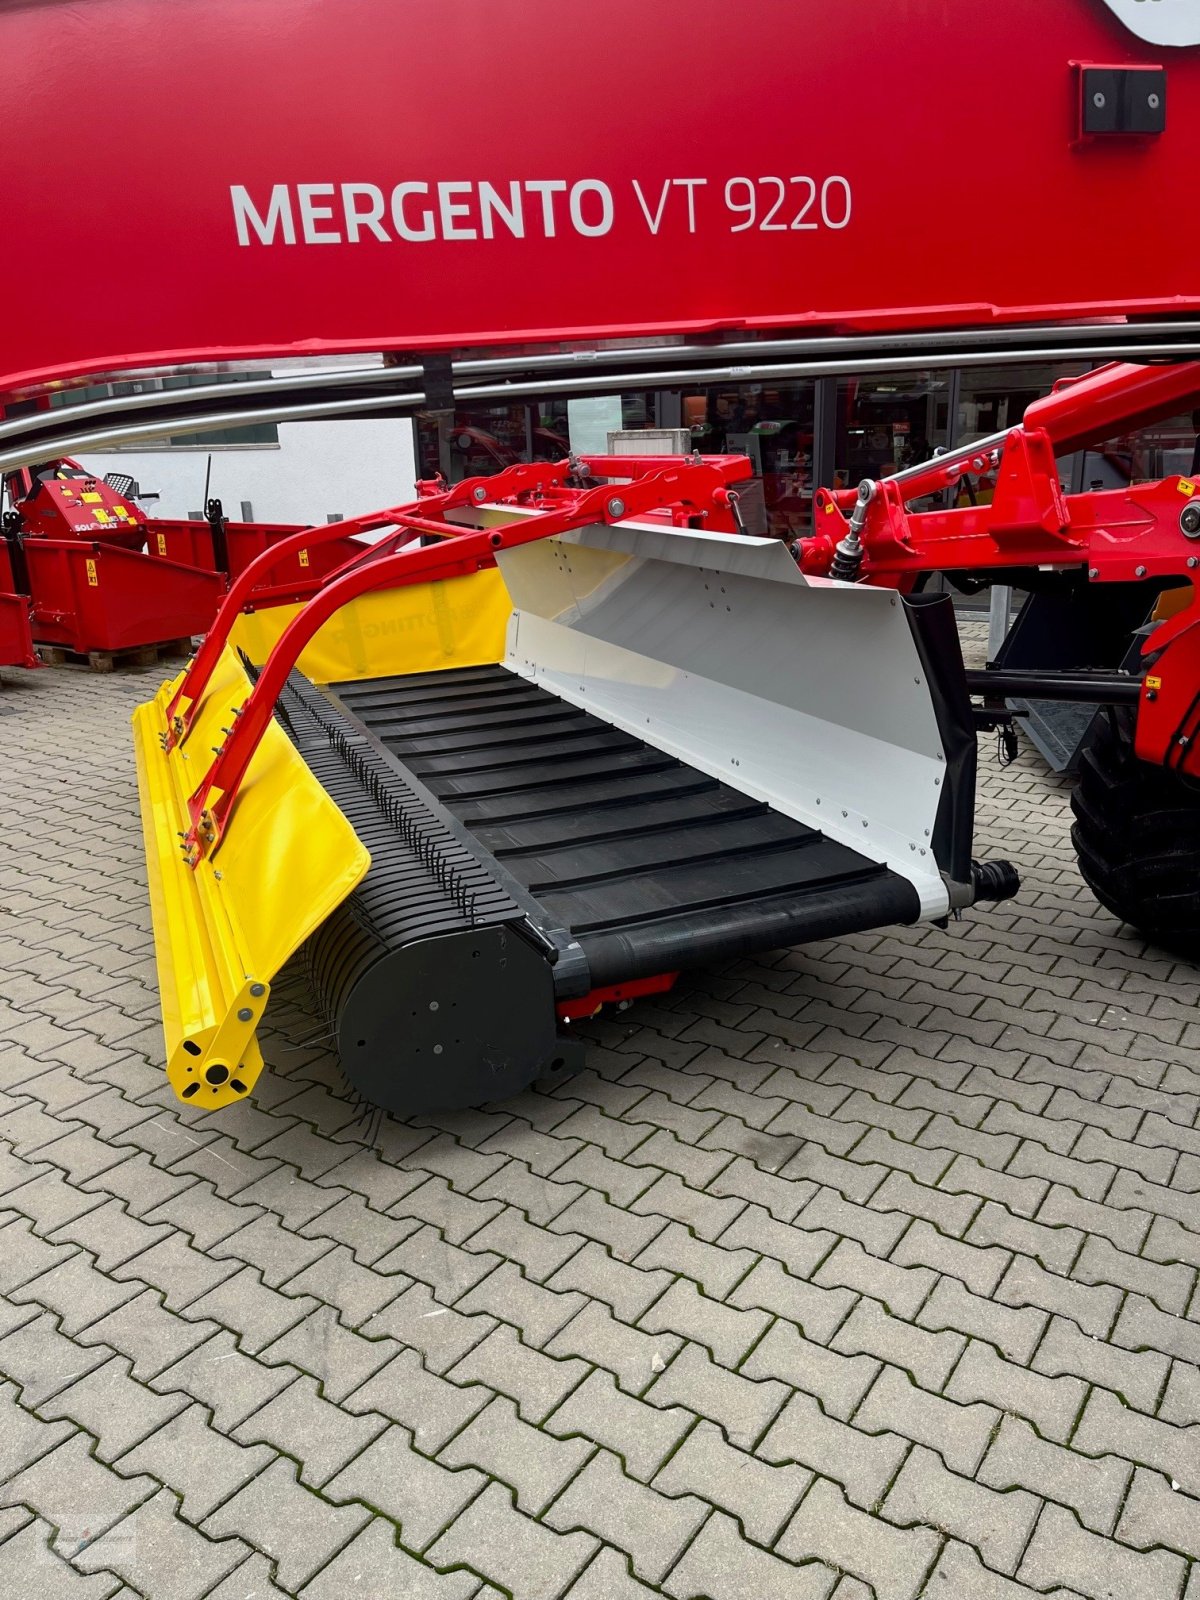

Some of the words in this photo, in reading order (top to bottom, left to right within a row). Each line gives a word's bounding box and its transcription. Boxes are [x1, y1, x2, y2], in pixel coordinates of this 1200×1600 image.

[229, 178, 614, 246] MERGENTO
[632, 178, 708, 236] VT
[724, 175, 853, 232] 9220
